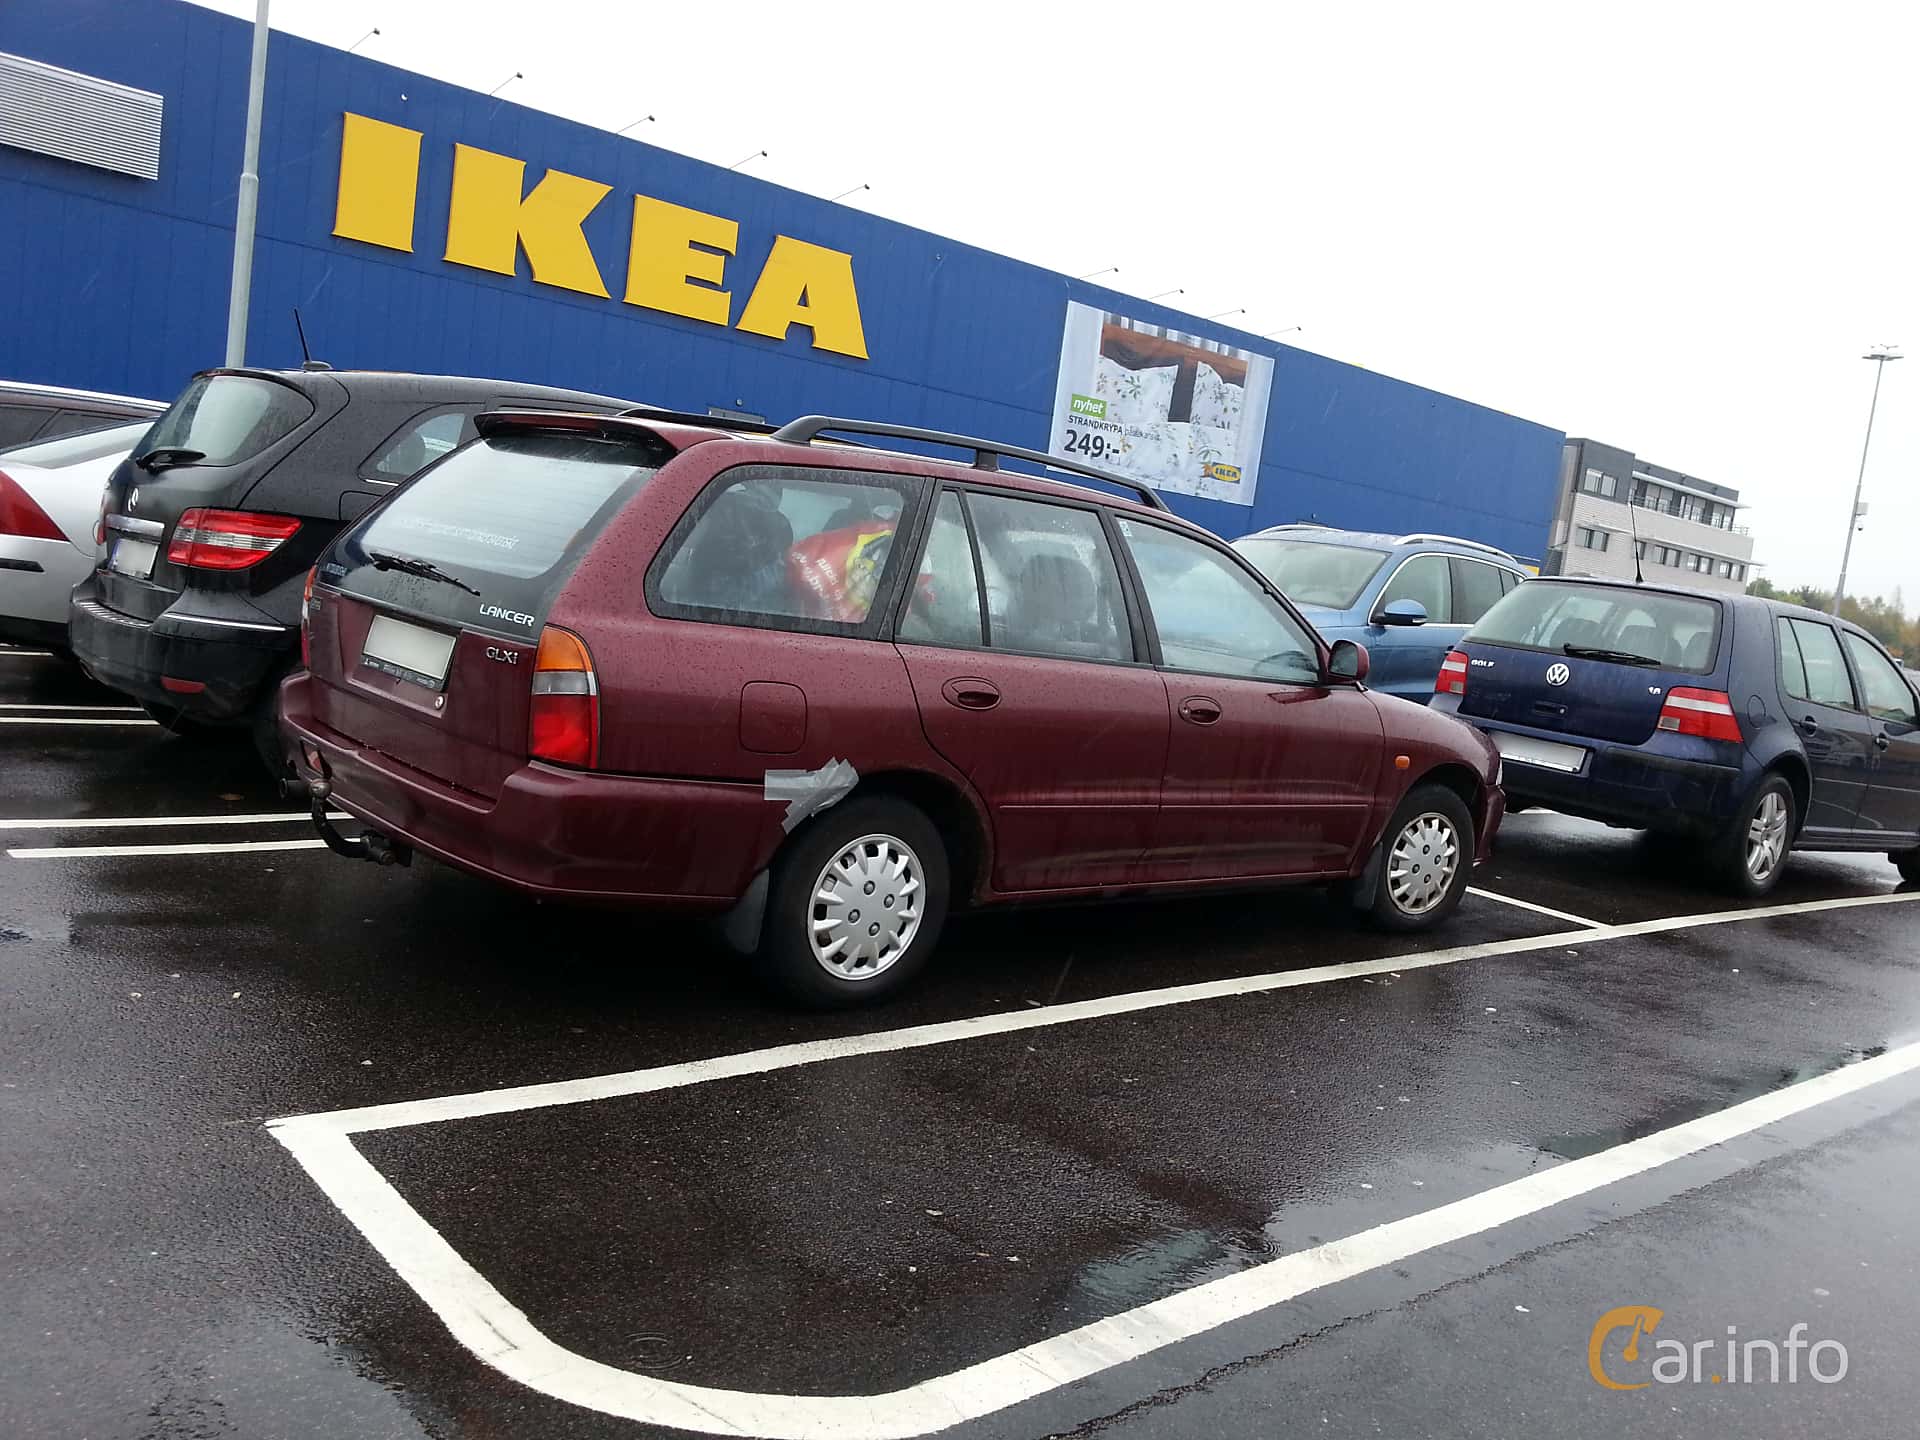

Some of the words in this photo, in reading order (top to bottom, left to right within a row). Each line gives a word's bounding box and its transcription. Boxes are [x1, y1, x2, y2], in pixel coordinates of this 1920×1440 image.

[331, 111, 870, 360] IKEA
[1073, 398, 1104, 414] nyhet
[1067, 414, 1123, 435] STRANDKRYPA
[1063, 428, 1120, 460] 249:-
[1215, 467, 1237, 479] IKEA
[479, 603, 535, 627] LANCER
[486, 646, 519, 665] GLXi
